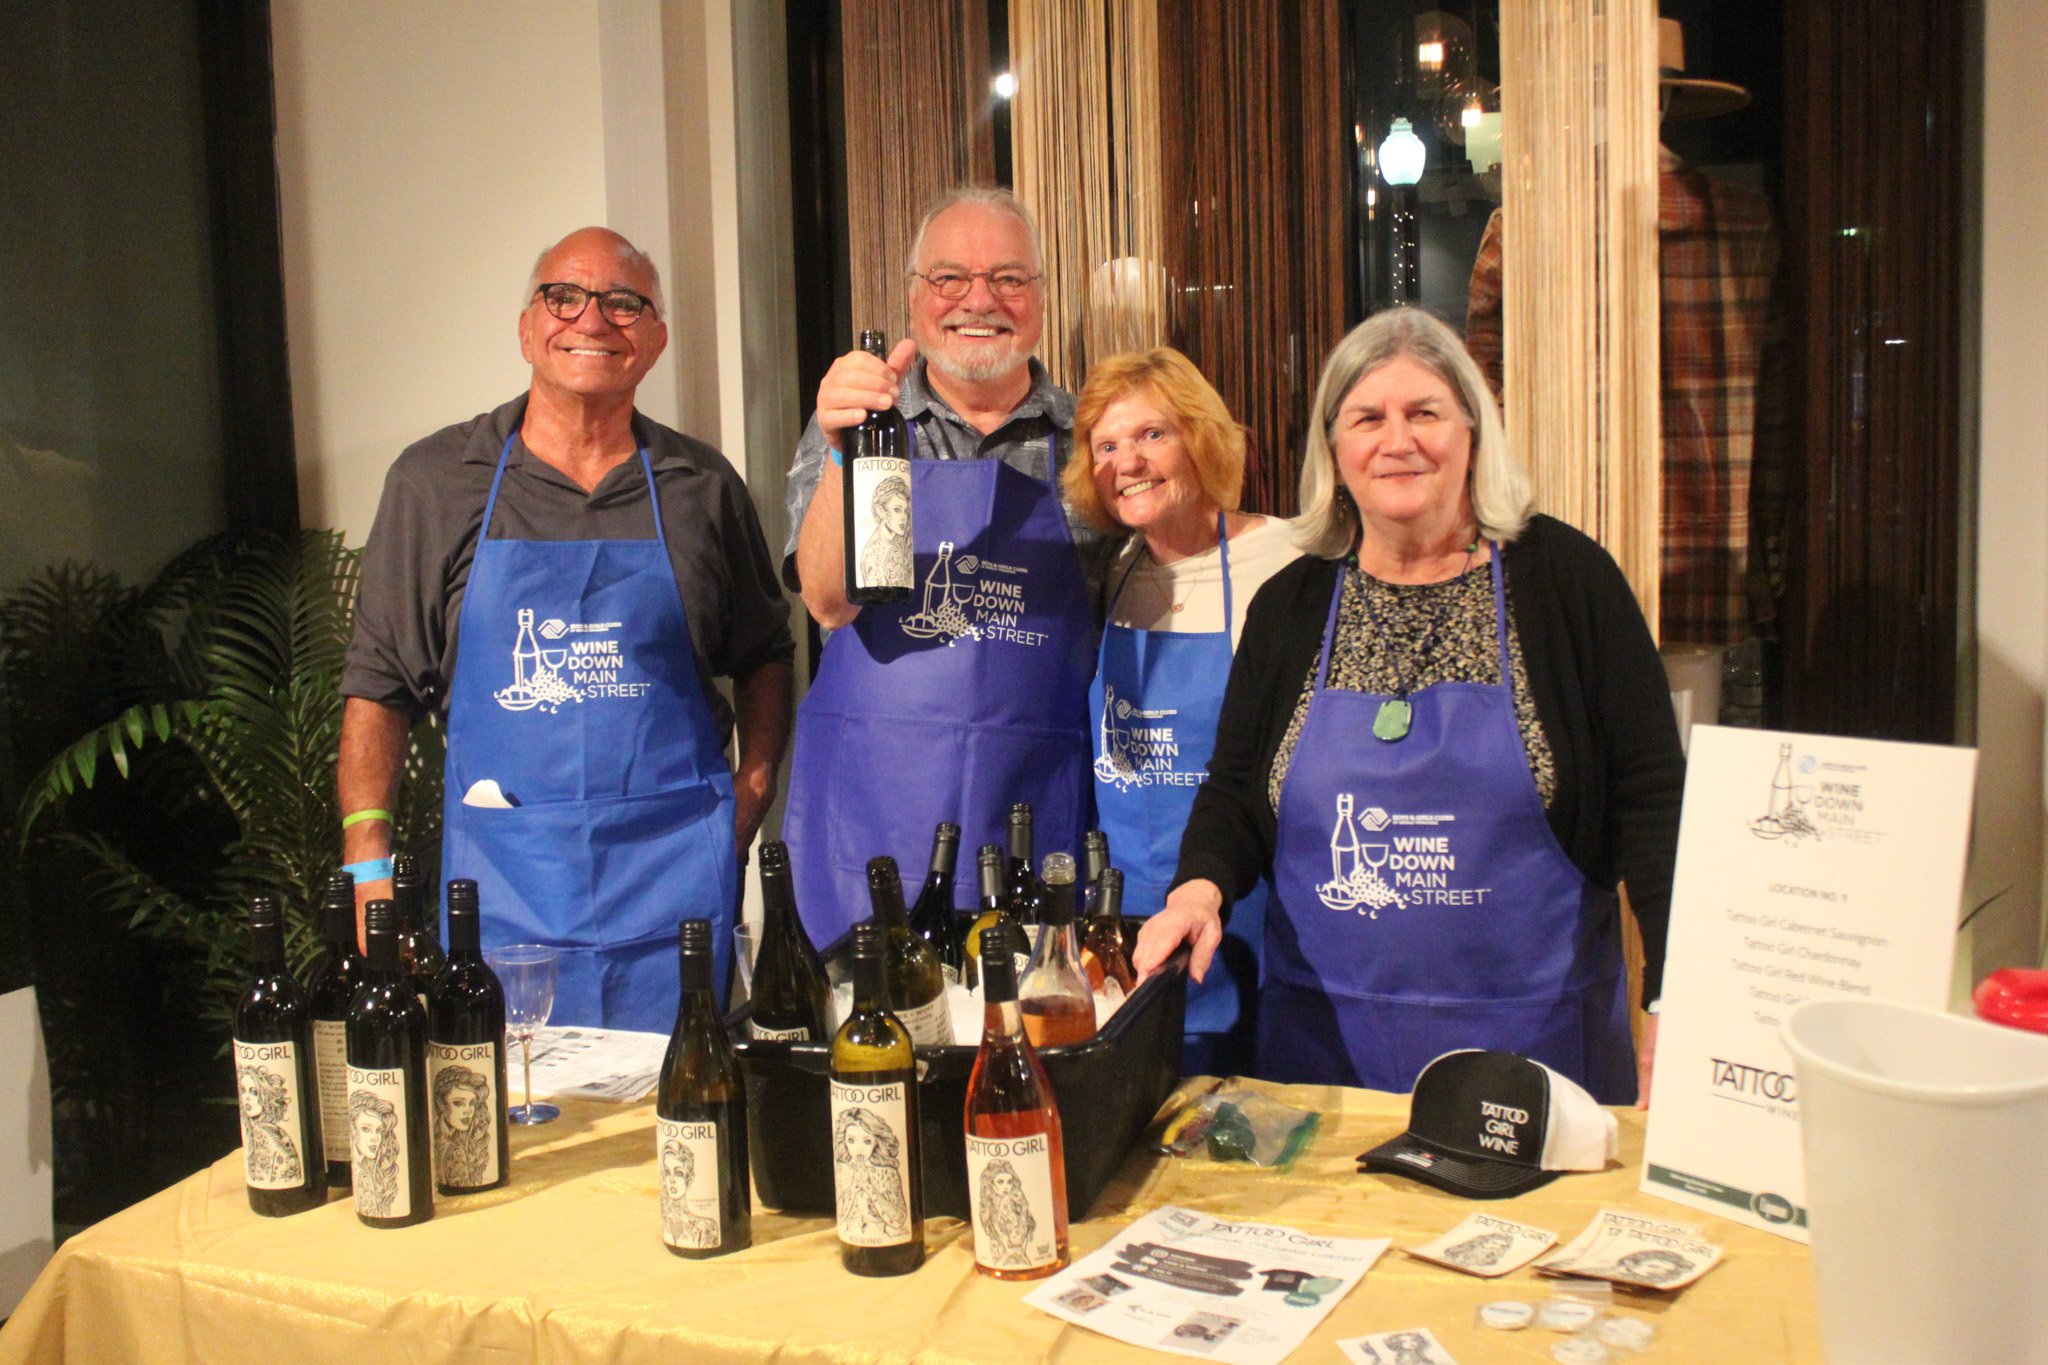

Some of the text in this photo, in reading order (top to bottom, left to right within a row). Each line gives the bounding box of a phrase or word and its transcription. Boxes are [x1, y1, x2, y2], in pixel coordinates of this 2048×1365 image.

[856, 459, 897, 472] TATTOO
[979, 579, 1022, 599] WINE
[973, 594, 1025, 614] DOWN
[975, 609, 1017, 628] MAIN
[986, 626, 1044, 646] STREET
[571, 640, 619, 655] WINE
[568, 655, 623, 670] DOWN
[574, 670, 616, 684] MAIN
[587, 683, 646, 698] STREET
[1131, 727, 1174, 742] WINE
[1130, 741, 1179, 757] DOWN
[1135, 757, 1172, 771] MAIN
[1143, 772, 1205, 786] STREET
[1820, 781, 1861, 797] WINE
[1814, 796, 1864, 812] DOWN
[1817, 811, 1856, 826] MAIN
[1393, 837, 1449, 853] WINE
[1389, 854, 1455, 871] DOWN
[1395, 872, 1447, 888] MAIN
[1411, 889, 1484, 906] STREET
[1768, 882, 1818, 898] LOCATION
[1727, 909, 1888, 947] Tattoo Girl Cabernet Sauvignon
[1744, 936, 1863, 970] Tattoo Girl Chardonnay
[1731, 958, 1872, 996] Tattoo Girl Red Wine Blend
[1749, 985, 1781, 1003] Tattoo
[257, 1045, 291, 1061] GIRL
[460, 1045, 492, 1061] GIRL
[366, 1071, 400, 1086] GIRL
[867, 1085, 902, 1104] GIRL
[1481, 1101, 1530, 1124] TATTOO
[681, 1124, 715, 1140] GIRL
[1485, 1119, 1516, 1139] GIRL
[967, 1137, 1046, 1158] TATTOO GIRL
[1479, 1133, 1519, 1155] WINE
[1212, 1222, 1285, 1239] TATTOO
[1288, 1235, 1336, 1250] GIRL
[1475, 1214, 1553, 1245] TATTOO GIRL
[1628, 1229, 1680, 1249] TATTOO
[1680, 1242, 1714, 1259] GIRL
